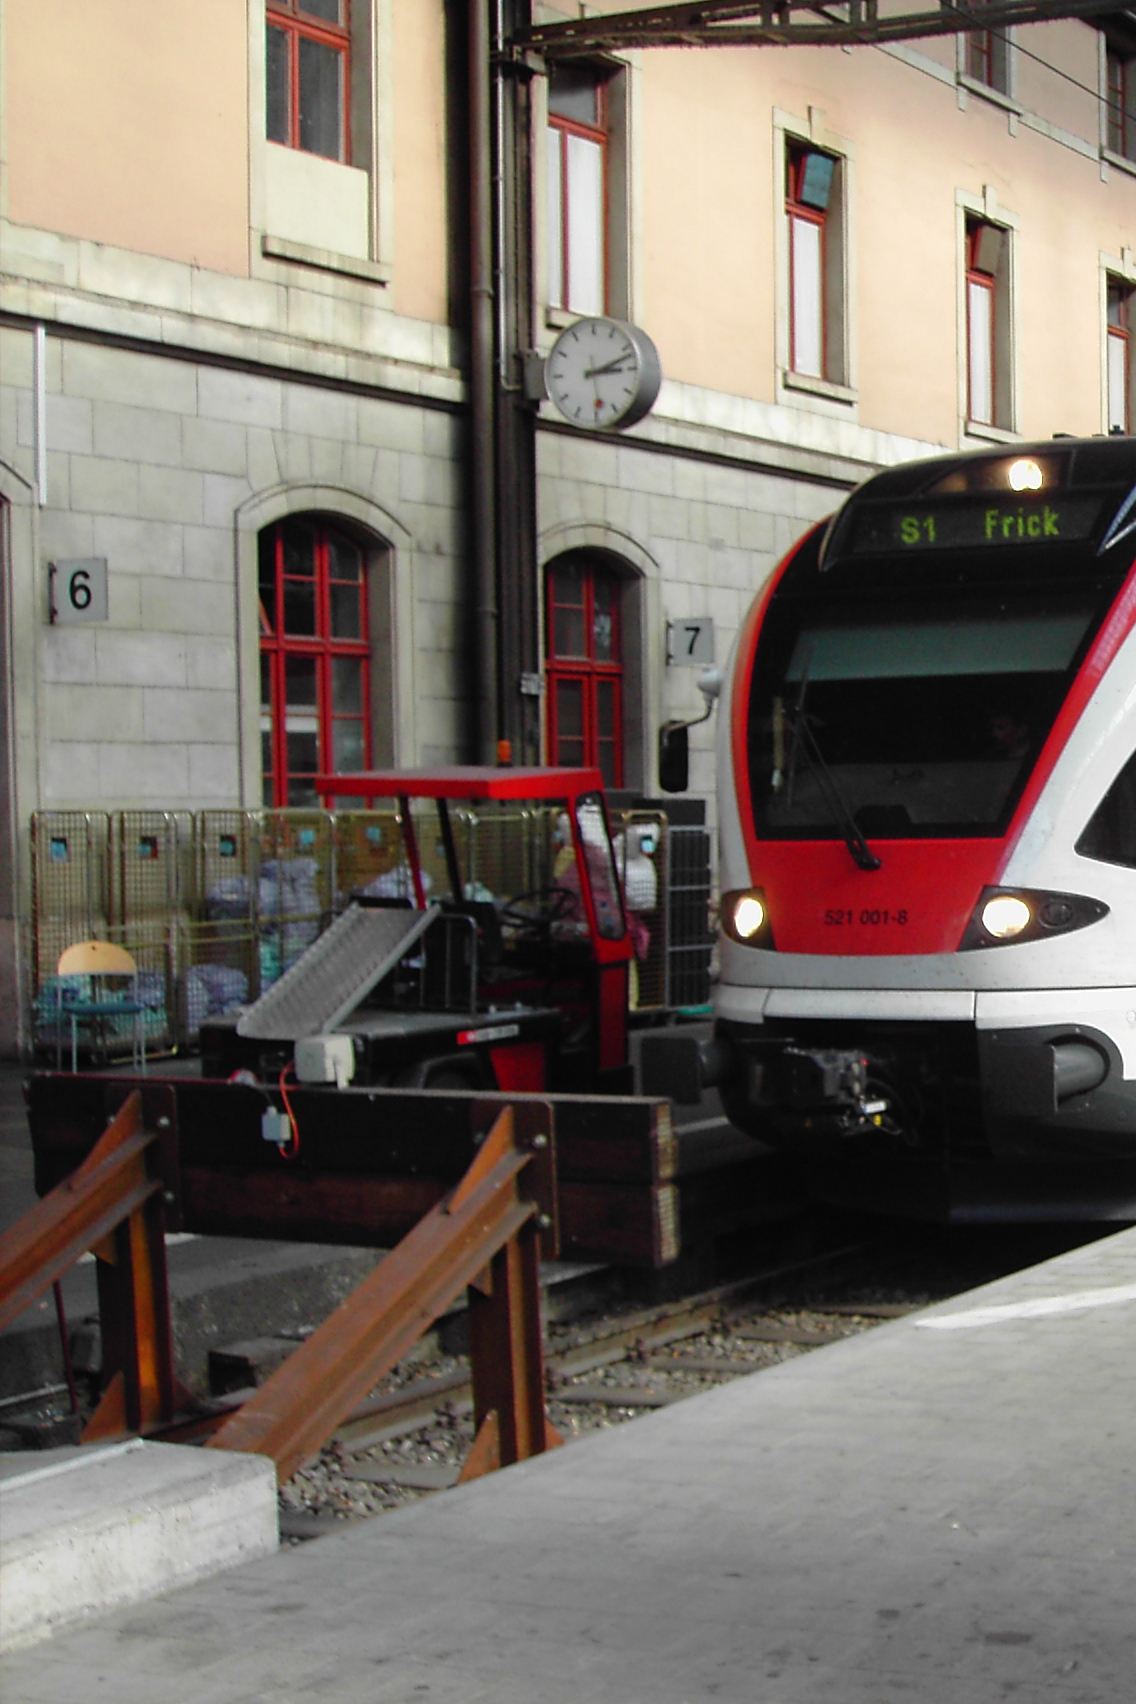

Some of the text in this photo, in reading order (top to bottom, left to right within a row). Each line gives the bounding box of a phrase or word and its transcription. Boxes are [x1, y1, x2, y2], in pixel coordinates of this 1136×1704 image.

[901, 506, 1059, 544] S1 Frick
[69, 569, 92, 610] 6
[684, 625, 701, 655] 7
[824, 909, 908, 925] 521 001-8
